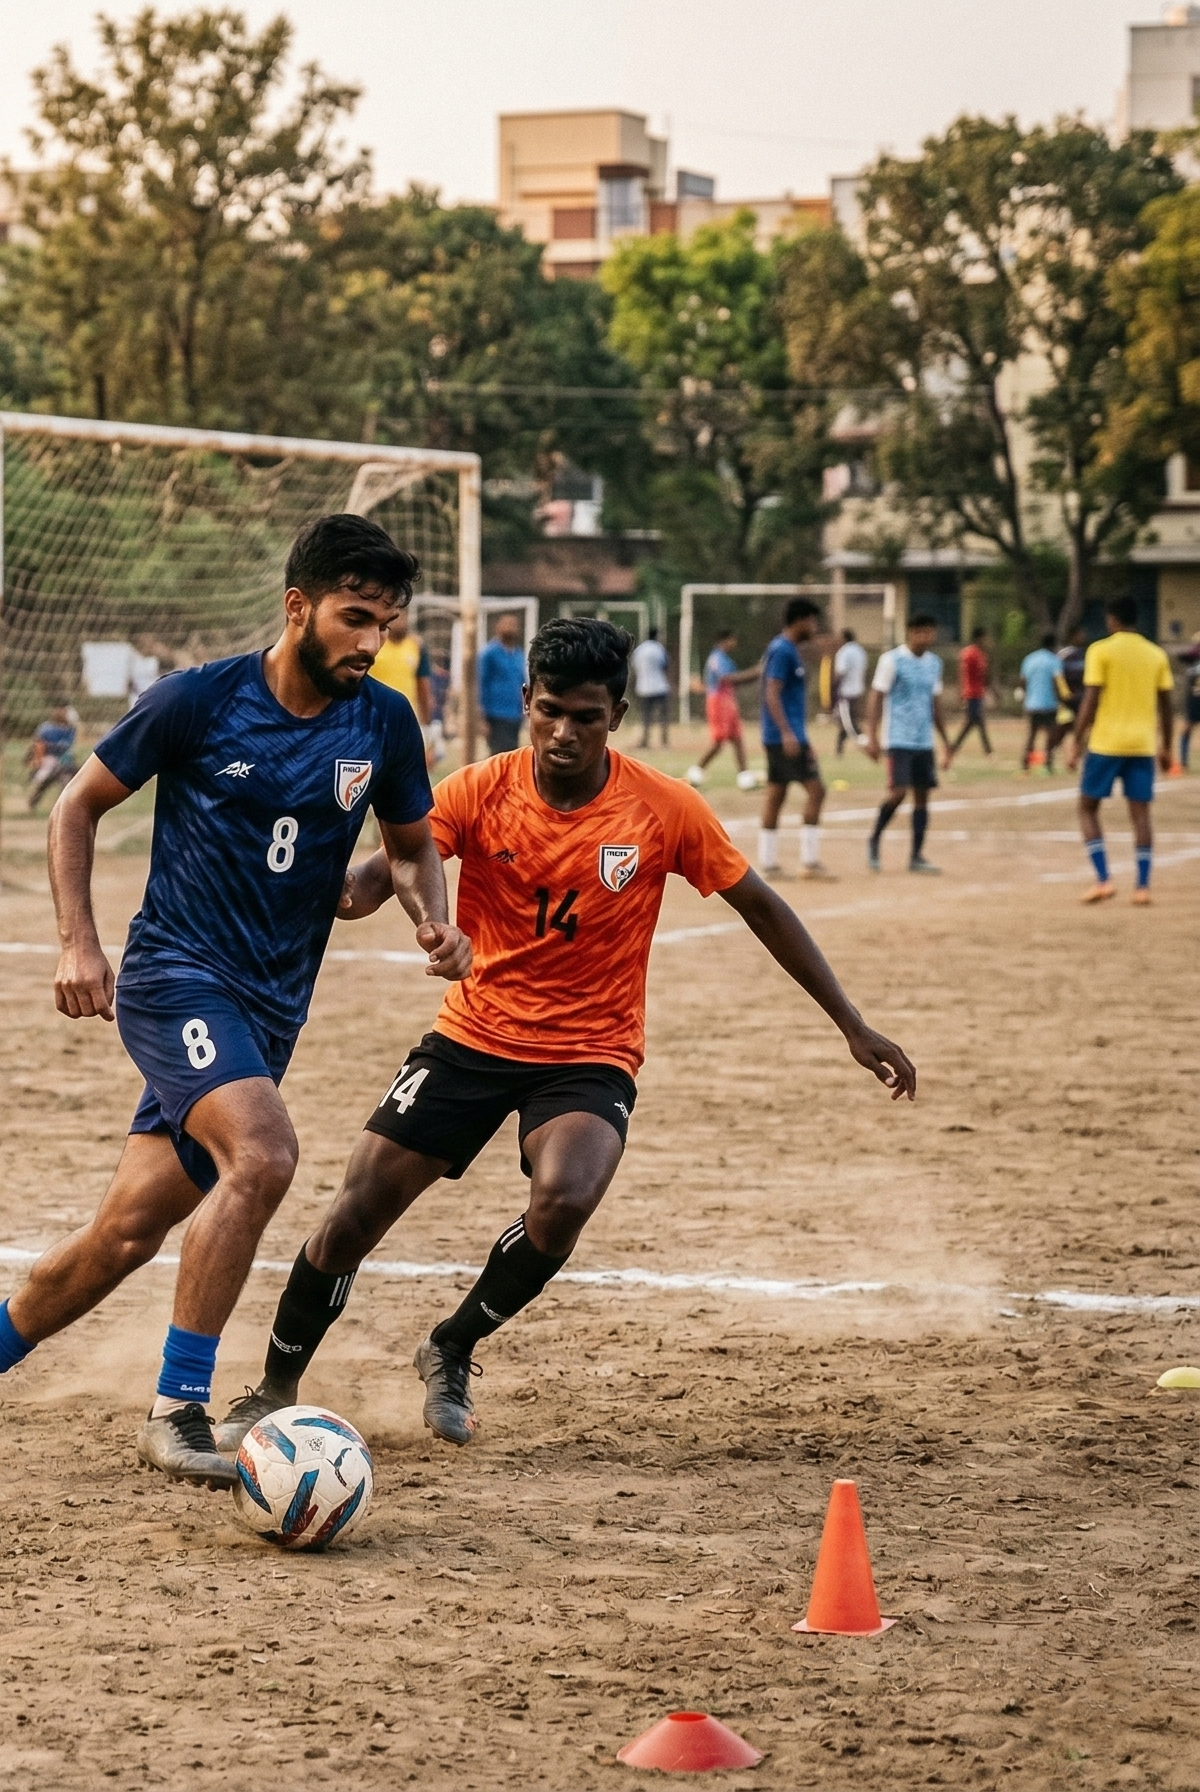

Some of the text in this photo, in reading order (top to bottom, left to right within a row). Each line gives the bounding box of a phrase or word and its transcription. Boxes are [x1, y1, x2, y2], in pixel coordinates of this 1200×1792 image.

[266, 816, 299, 873] 8
[534, 887, 580, 942] 14
[182, 1018, 217, 1070] 8
